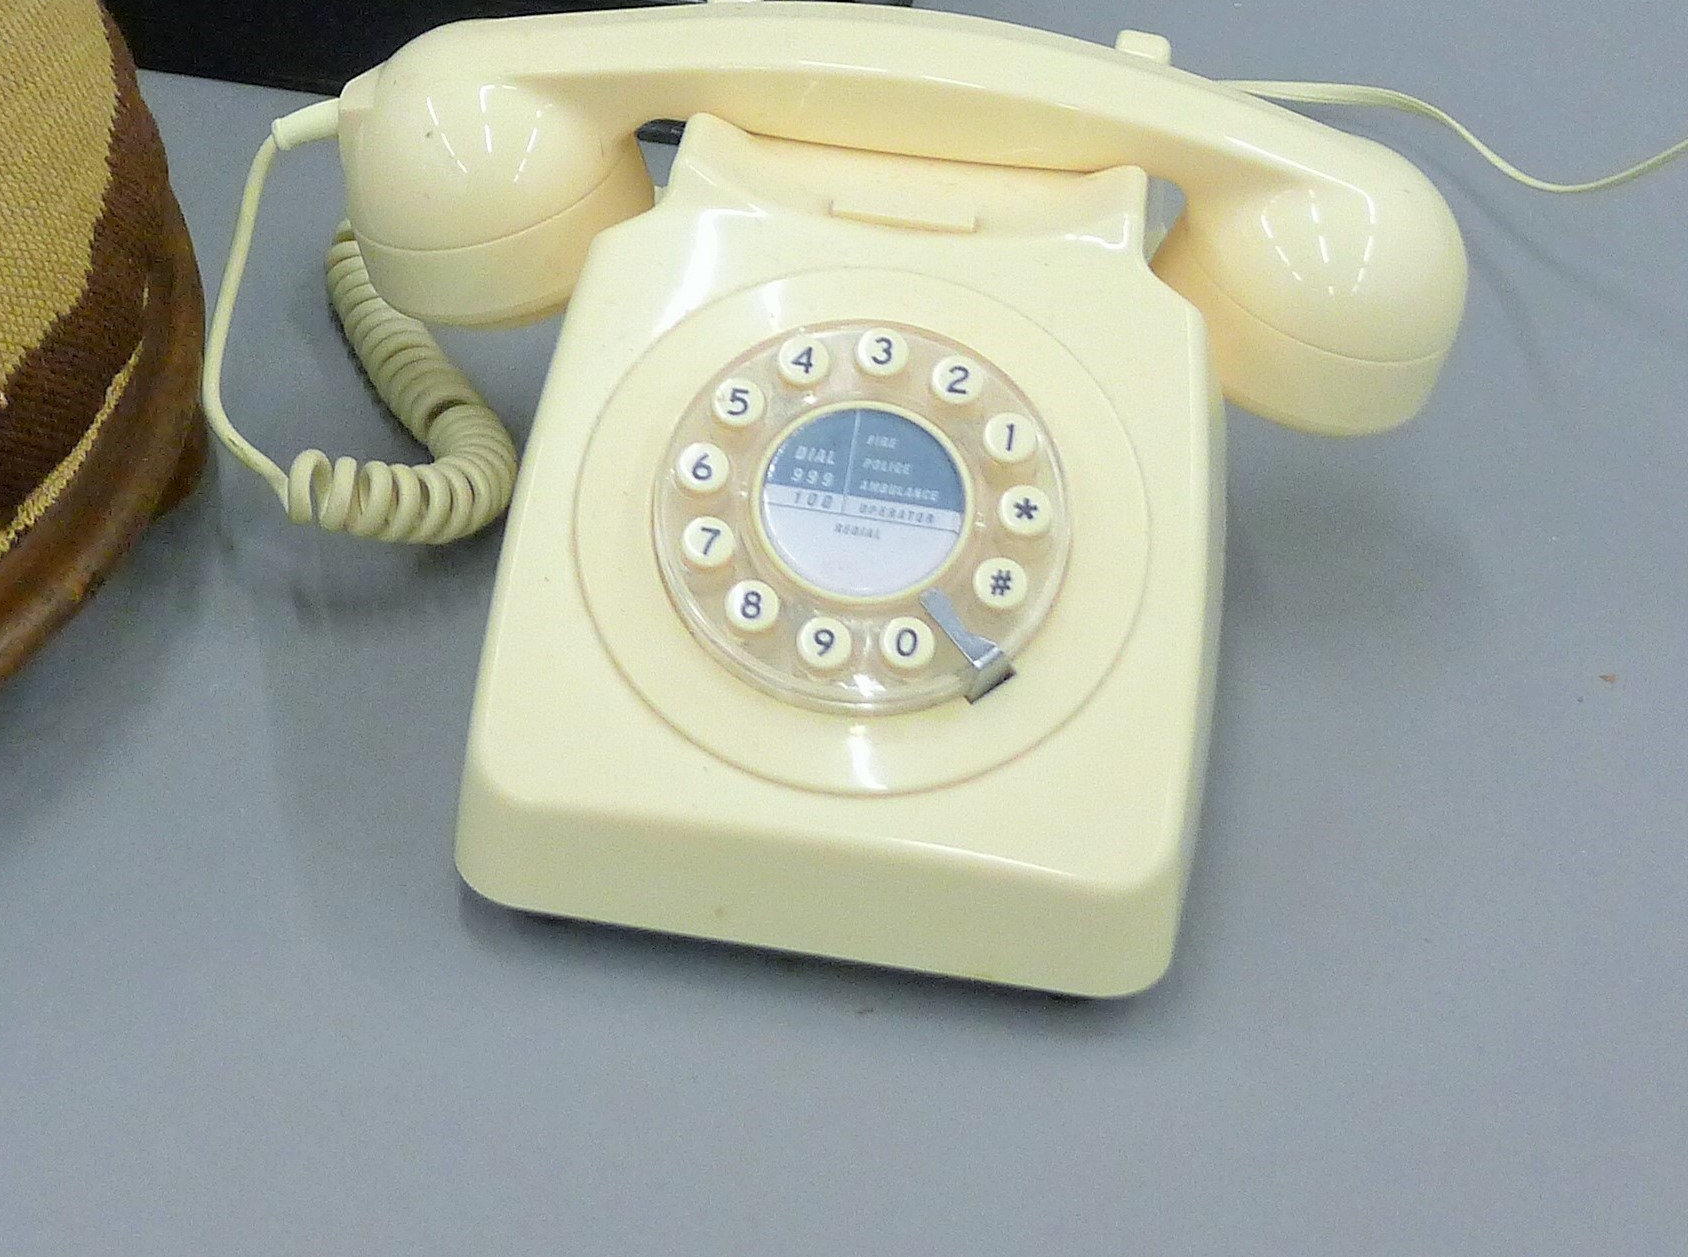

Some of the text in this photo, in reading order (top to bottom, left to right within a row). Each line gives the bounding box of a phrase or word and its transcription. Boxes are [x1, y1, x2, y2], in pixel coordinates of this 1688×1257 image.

[792, 347, 812, 373] 4
[872, 338, 892, 364] 3
[948, 366, 968, 394] 2
[728, 389, 748, 415] 5
[1006, 424, 1014, 451] 1
[692, 453, 711, 480] 6
[794, 445, 836, 465] DIAL
[863, 459, 912, 475] POLICE
[791, 467, 835, 486] 999
[793, 492, 833, 509] 100
[860, 481, 939, 501] AMBULANCE
[859, 504, 935, 524] OPERATOR
[702, 528, 720, 555] 7
[991, 570, 1011, 596] #
[742, 591, 761, 619] 8
[815, 629, 834, 656] 9
[897, 629, 917, 656] 0
